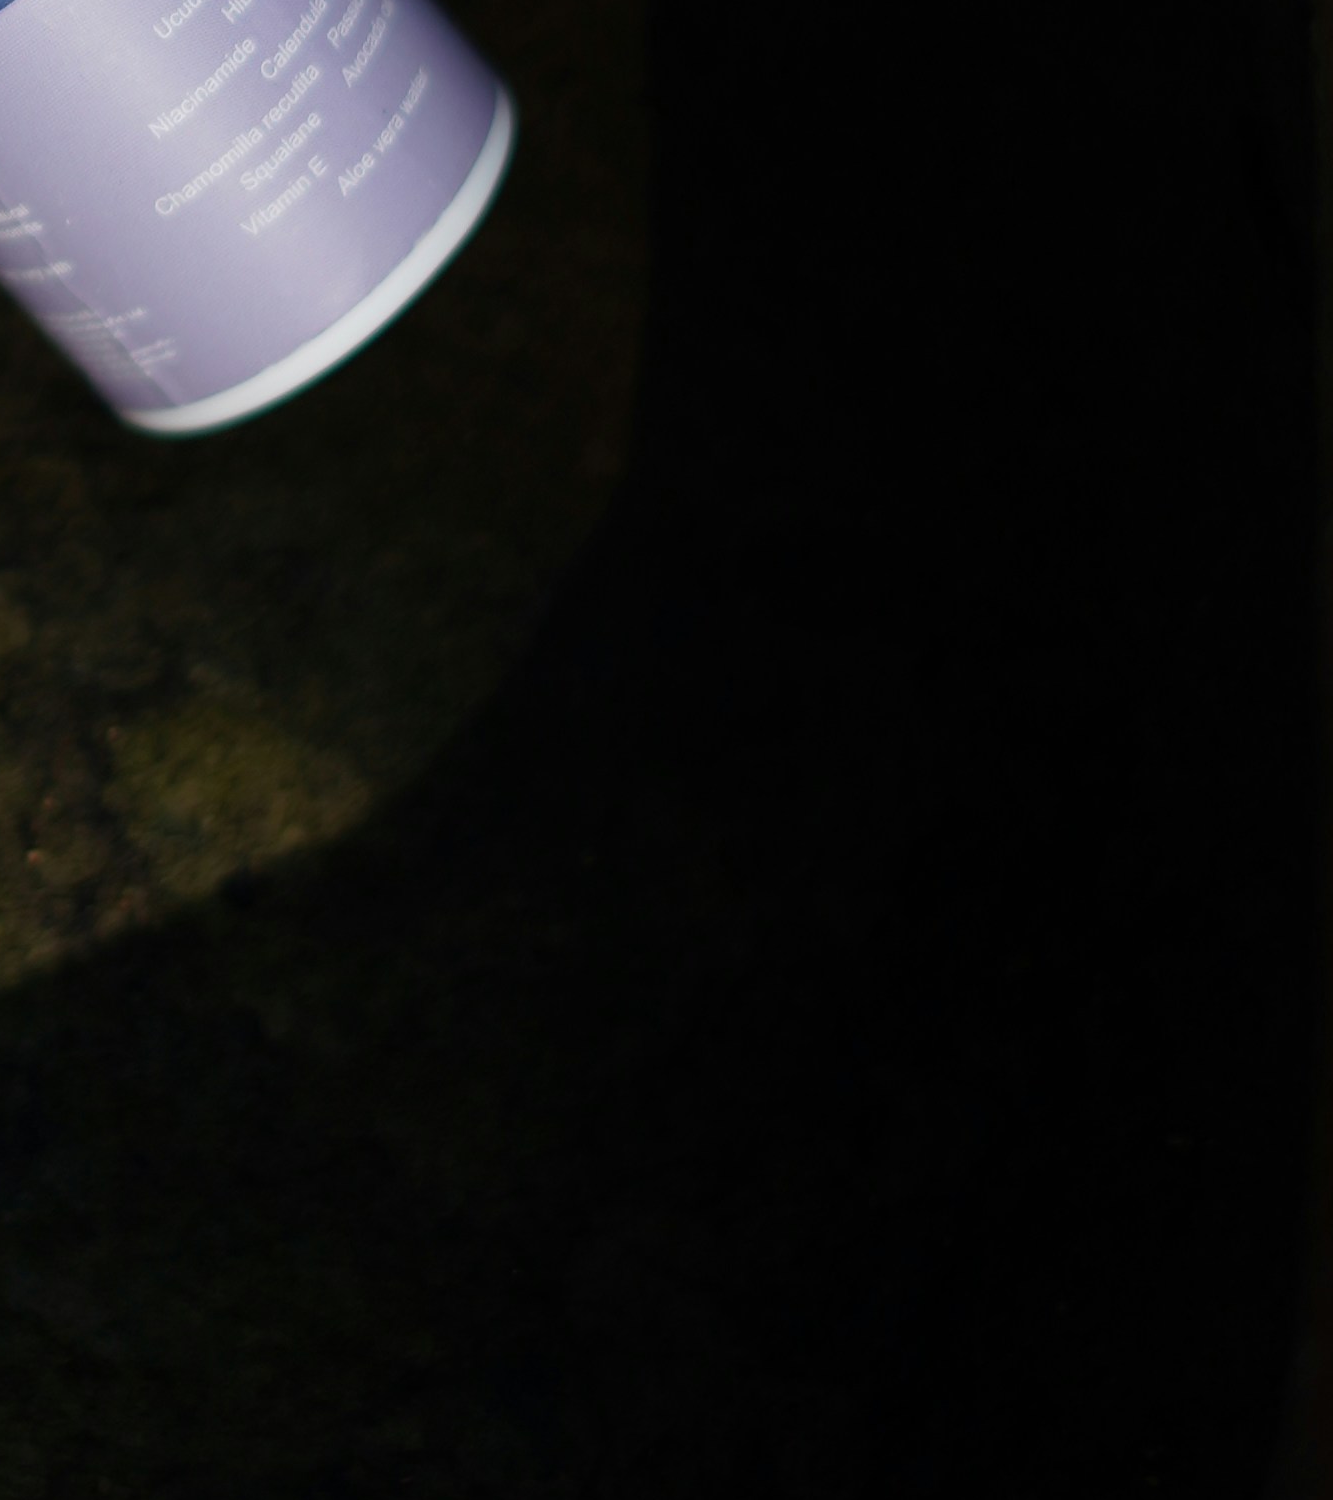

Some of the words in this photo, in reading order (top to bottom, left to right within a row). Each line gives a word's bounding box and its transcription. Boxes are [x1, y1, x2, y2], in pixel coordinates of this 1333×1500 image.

[147, 36, 257, 140] Niacinamide
[154, 126, 265, 217] Chamomilla
[262, 62, 321, 131] recutita
[239, 110, 323, 192] Squalane
[337, 151, 377, 197] Aloe
[373, 115, 406, 153] vera
[239, 172, 313, 238] Vitamin
[307, 154, 330, 178] E
